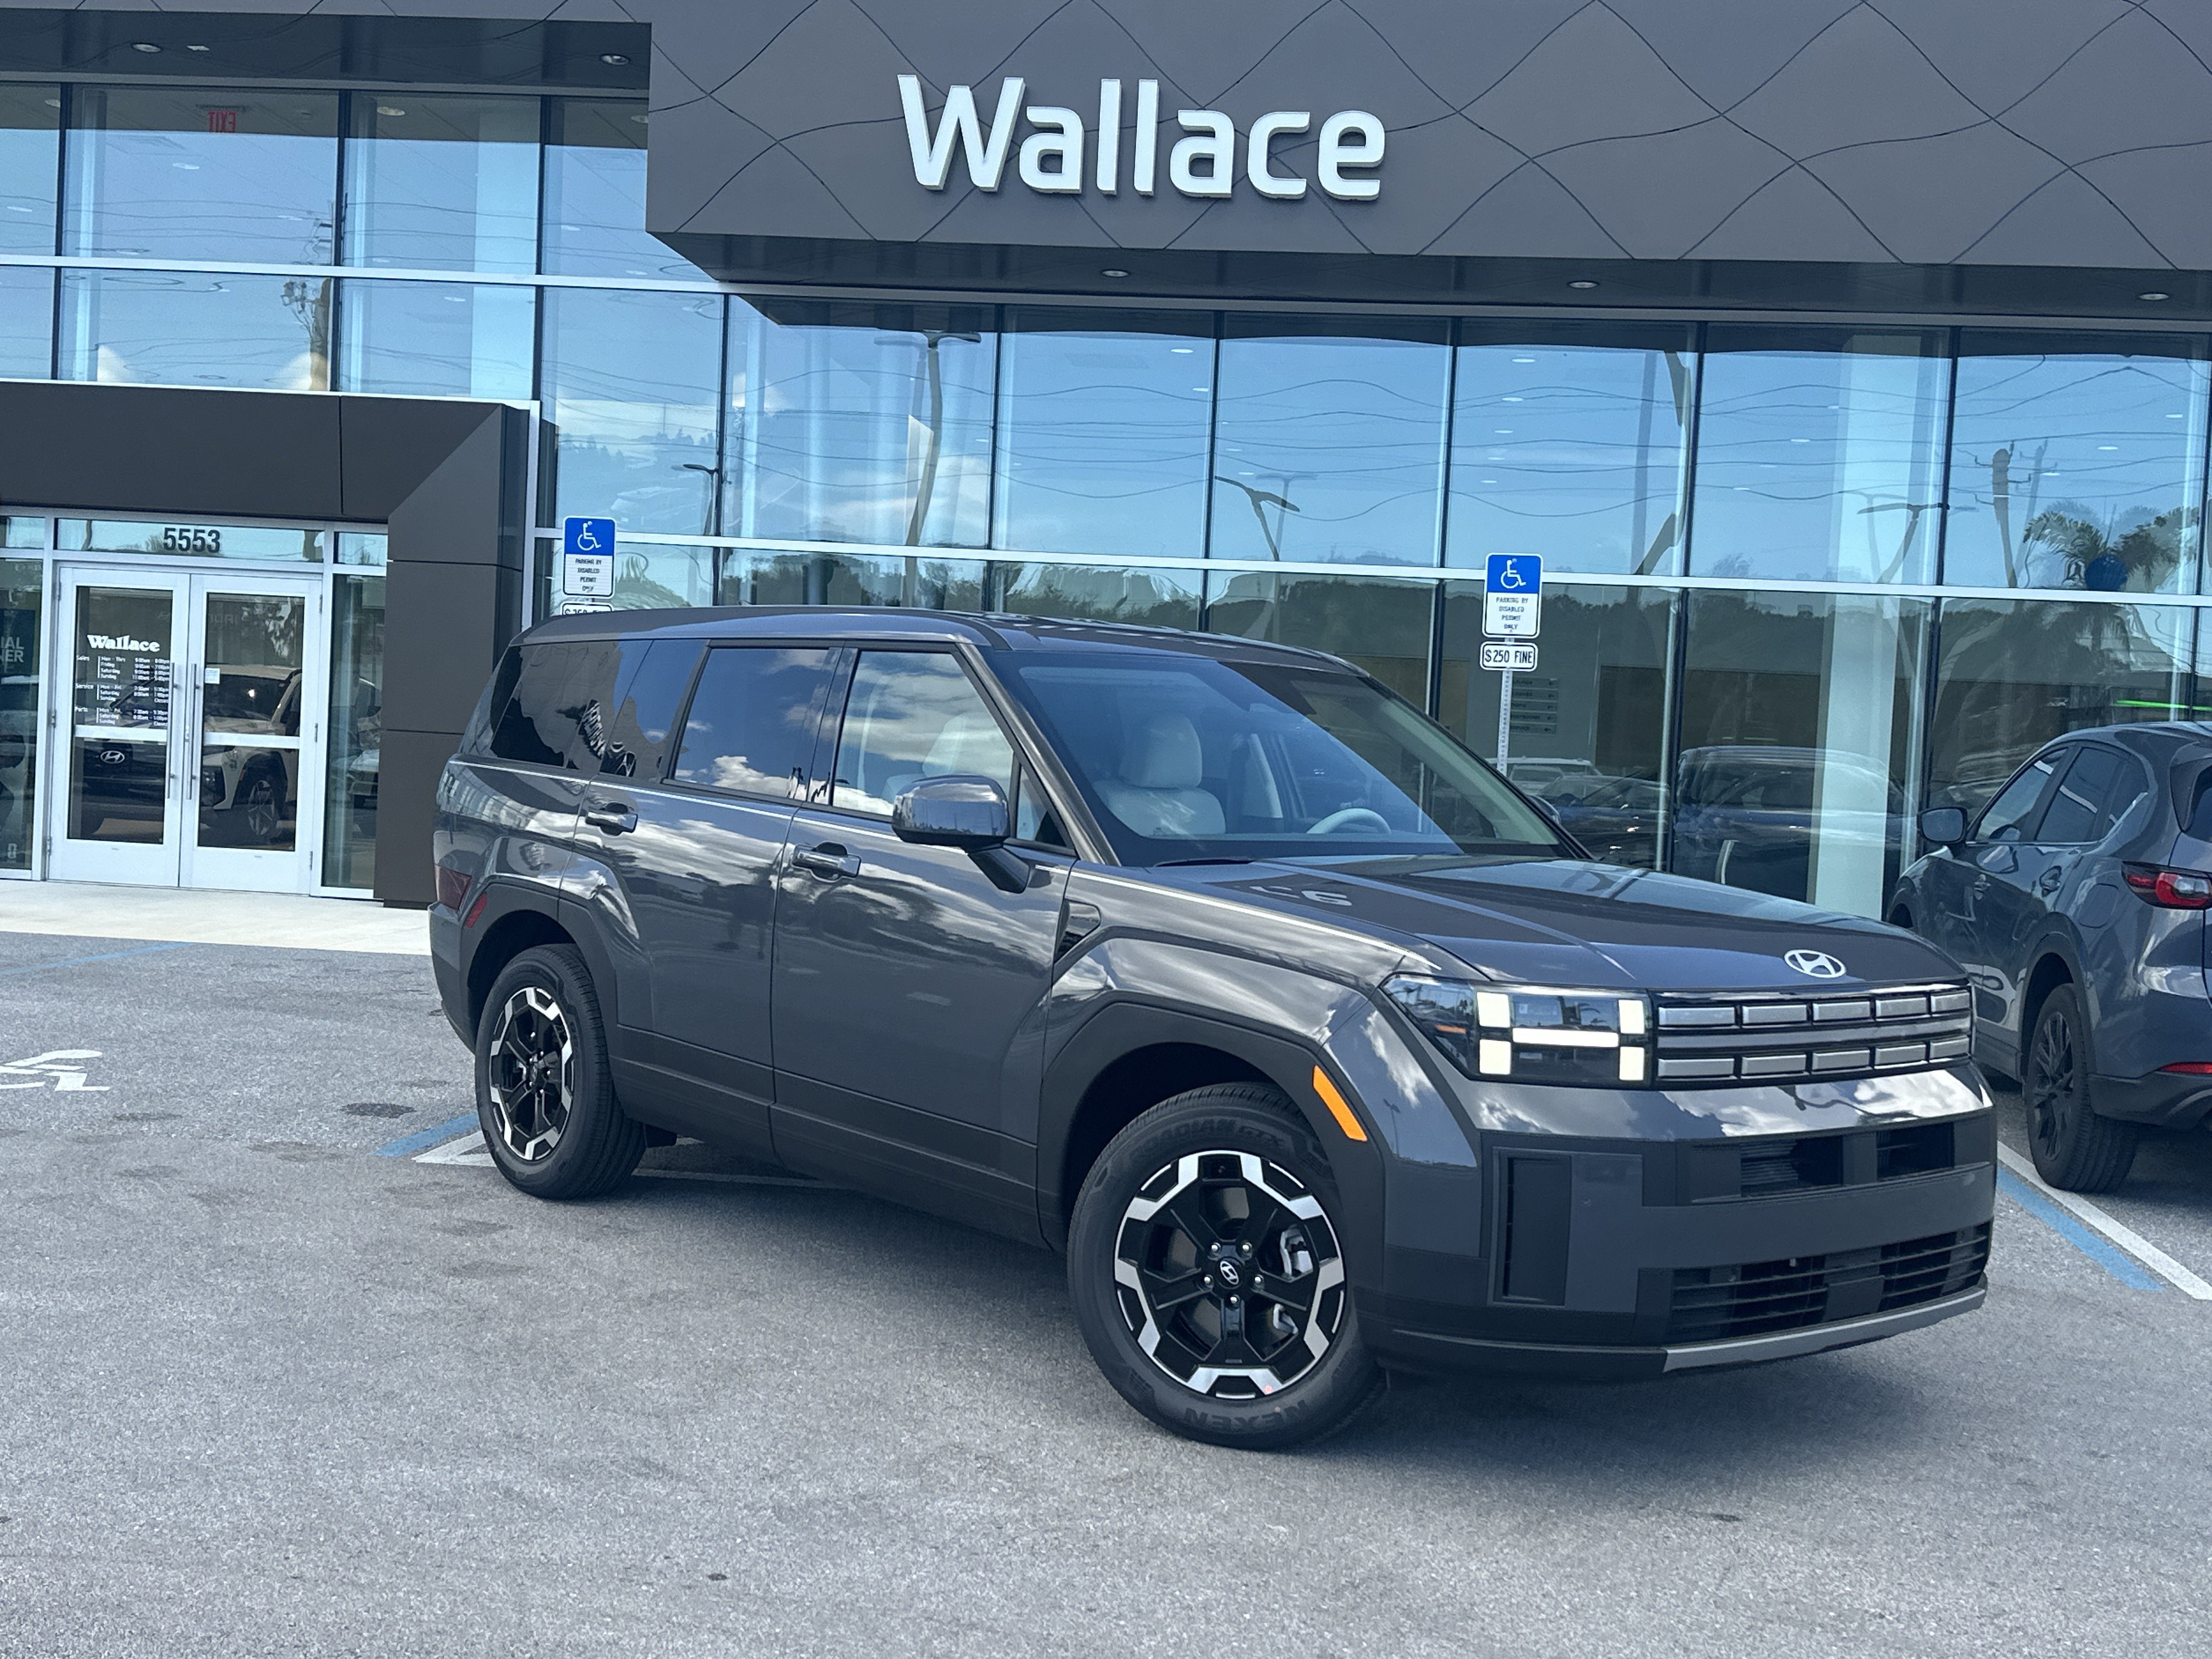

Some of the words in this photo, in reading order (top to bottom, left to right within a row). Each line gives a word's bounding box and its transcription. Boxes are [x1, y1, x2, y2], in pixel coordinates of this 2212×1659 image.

[896, 74, 1385, 201] Wallace
[163, 527, 220, 553] 5553
[87, 635, 160, 652] Wallace
[1485, 648, 1510, 663] $250
[1514, 650, 1533, 663] FINE
[1184, 1400, 1309, 1434] NEXEN
